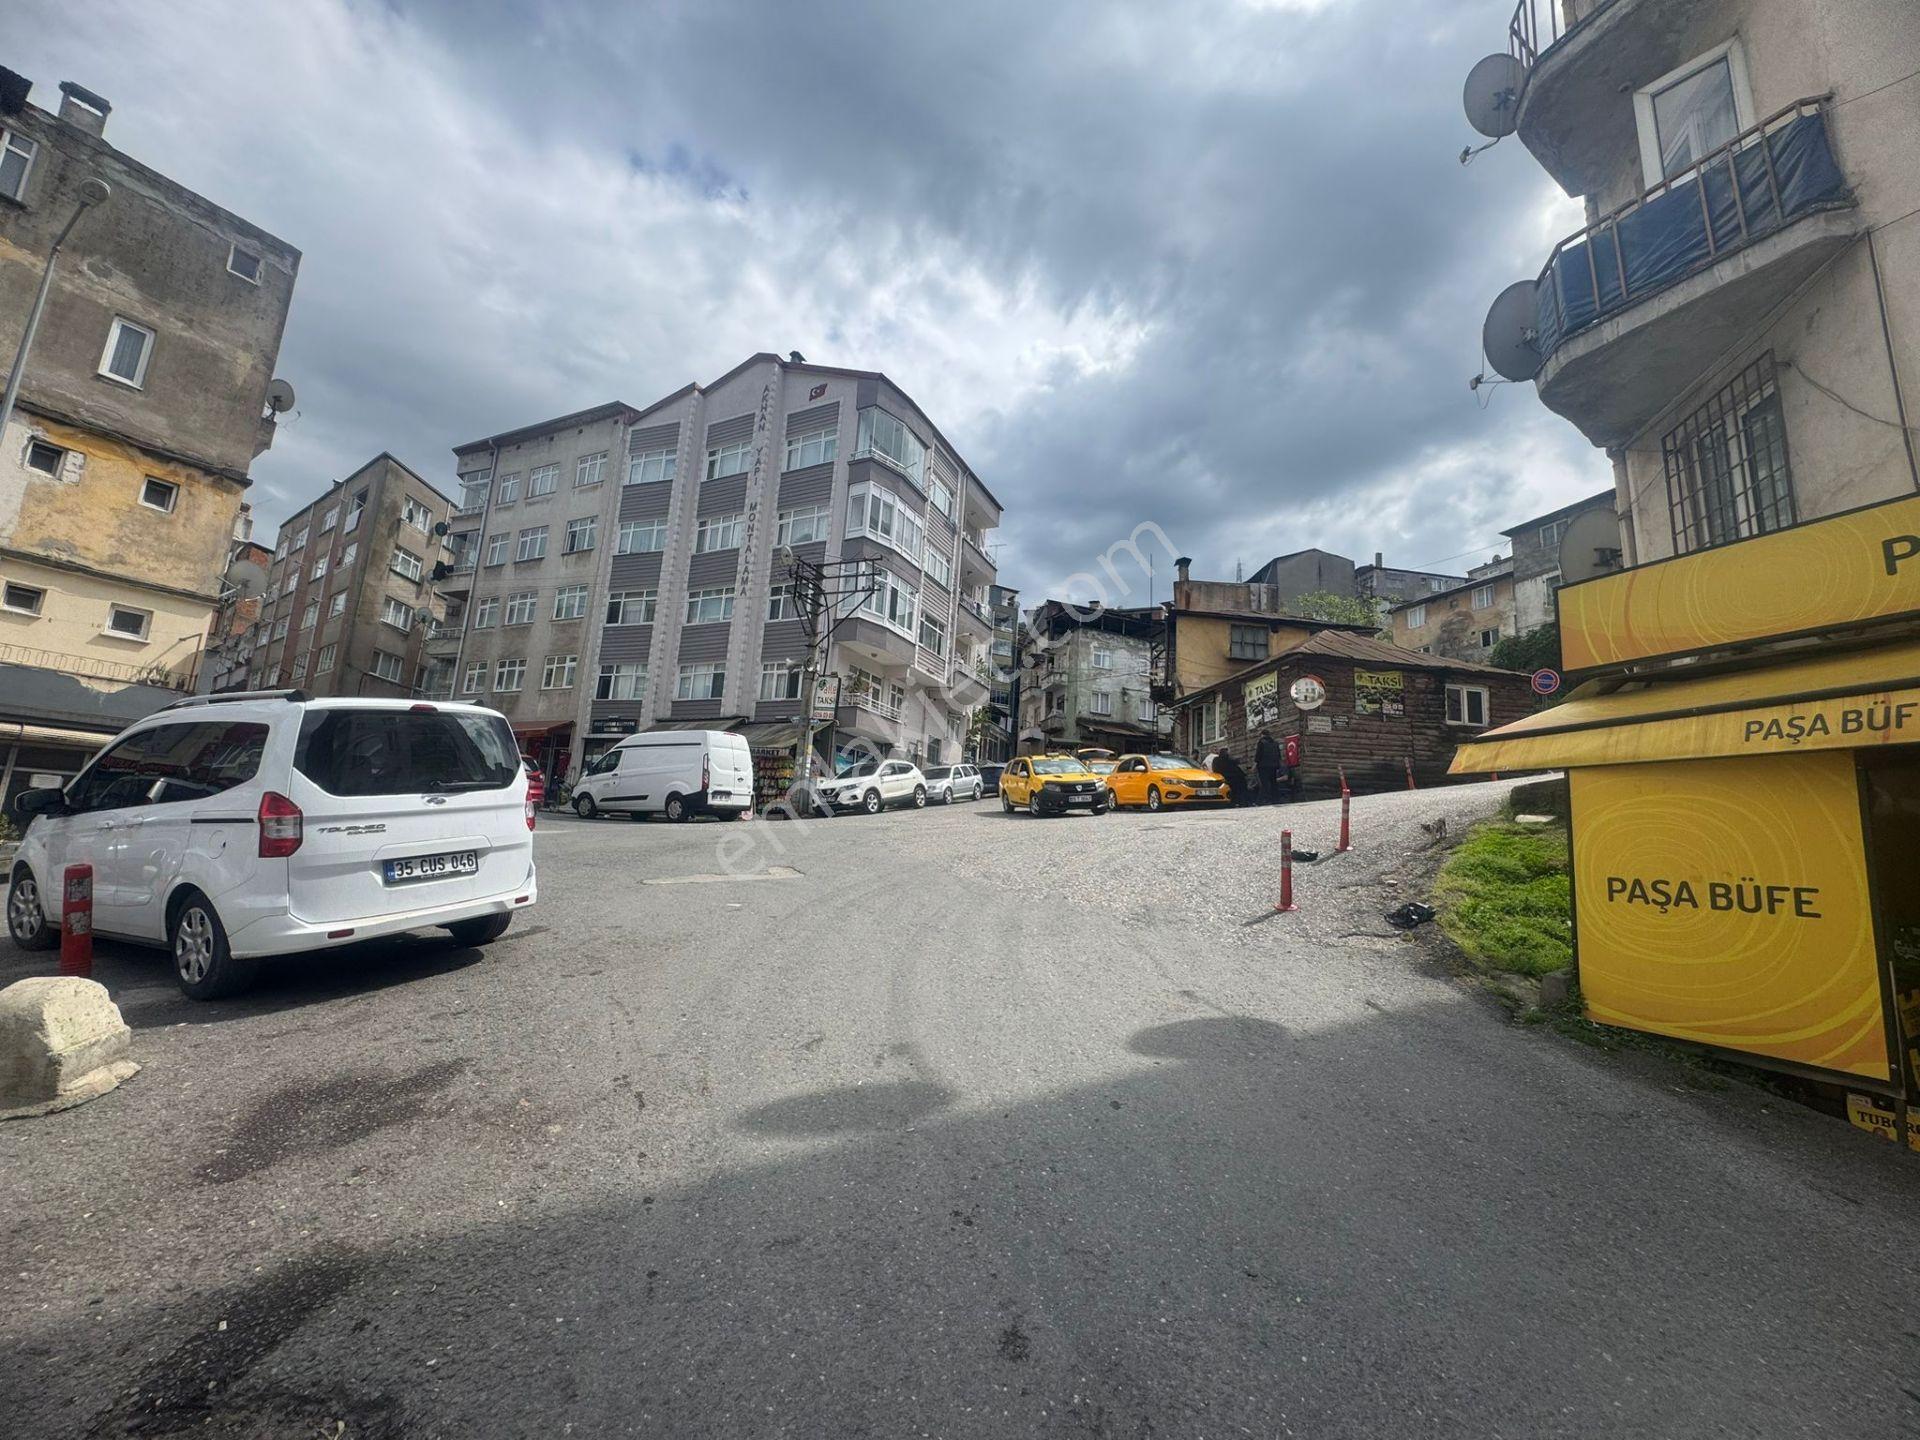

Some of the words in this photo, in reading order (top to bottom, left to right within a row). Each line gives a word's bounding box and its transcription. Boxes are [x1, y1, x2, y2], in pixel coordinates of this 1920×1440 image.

[753, 447, 763, 486] YAPI
[740, 502, 757, 596] MONTALAMA
[1744, 713, 1830, 745] PAŞA
[1841, 699, 1919, 734] BÜF
[395, 862, 414, 877] 35
[420, 857, 446, 874] CUS
[451, 853, 475, 870] 046
[1606, 876, 1699, 914] PAŞA
[1709, 877, 1822, 919] BÜFE
